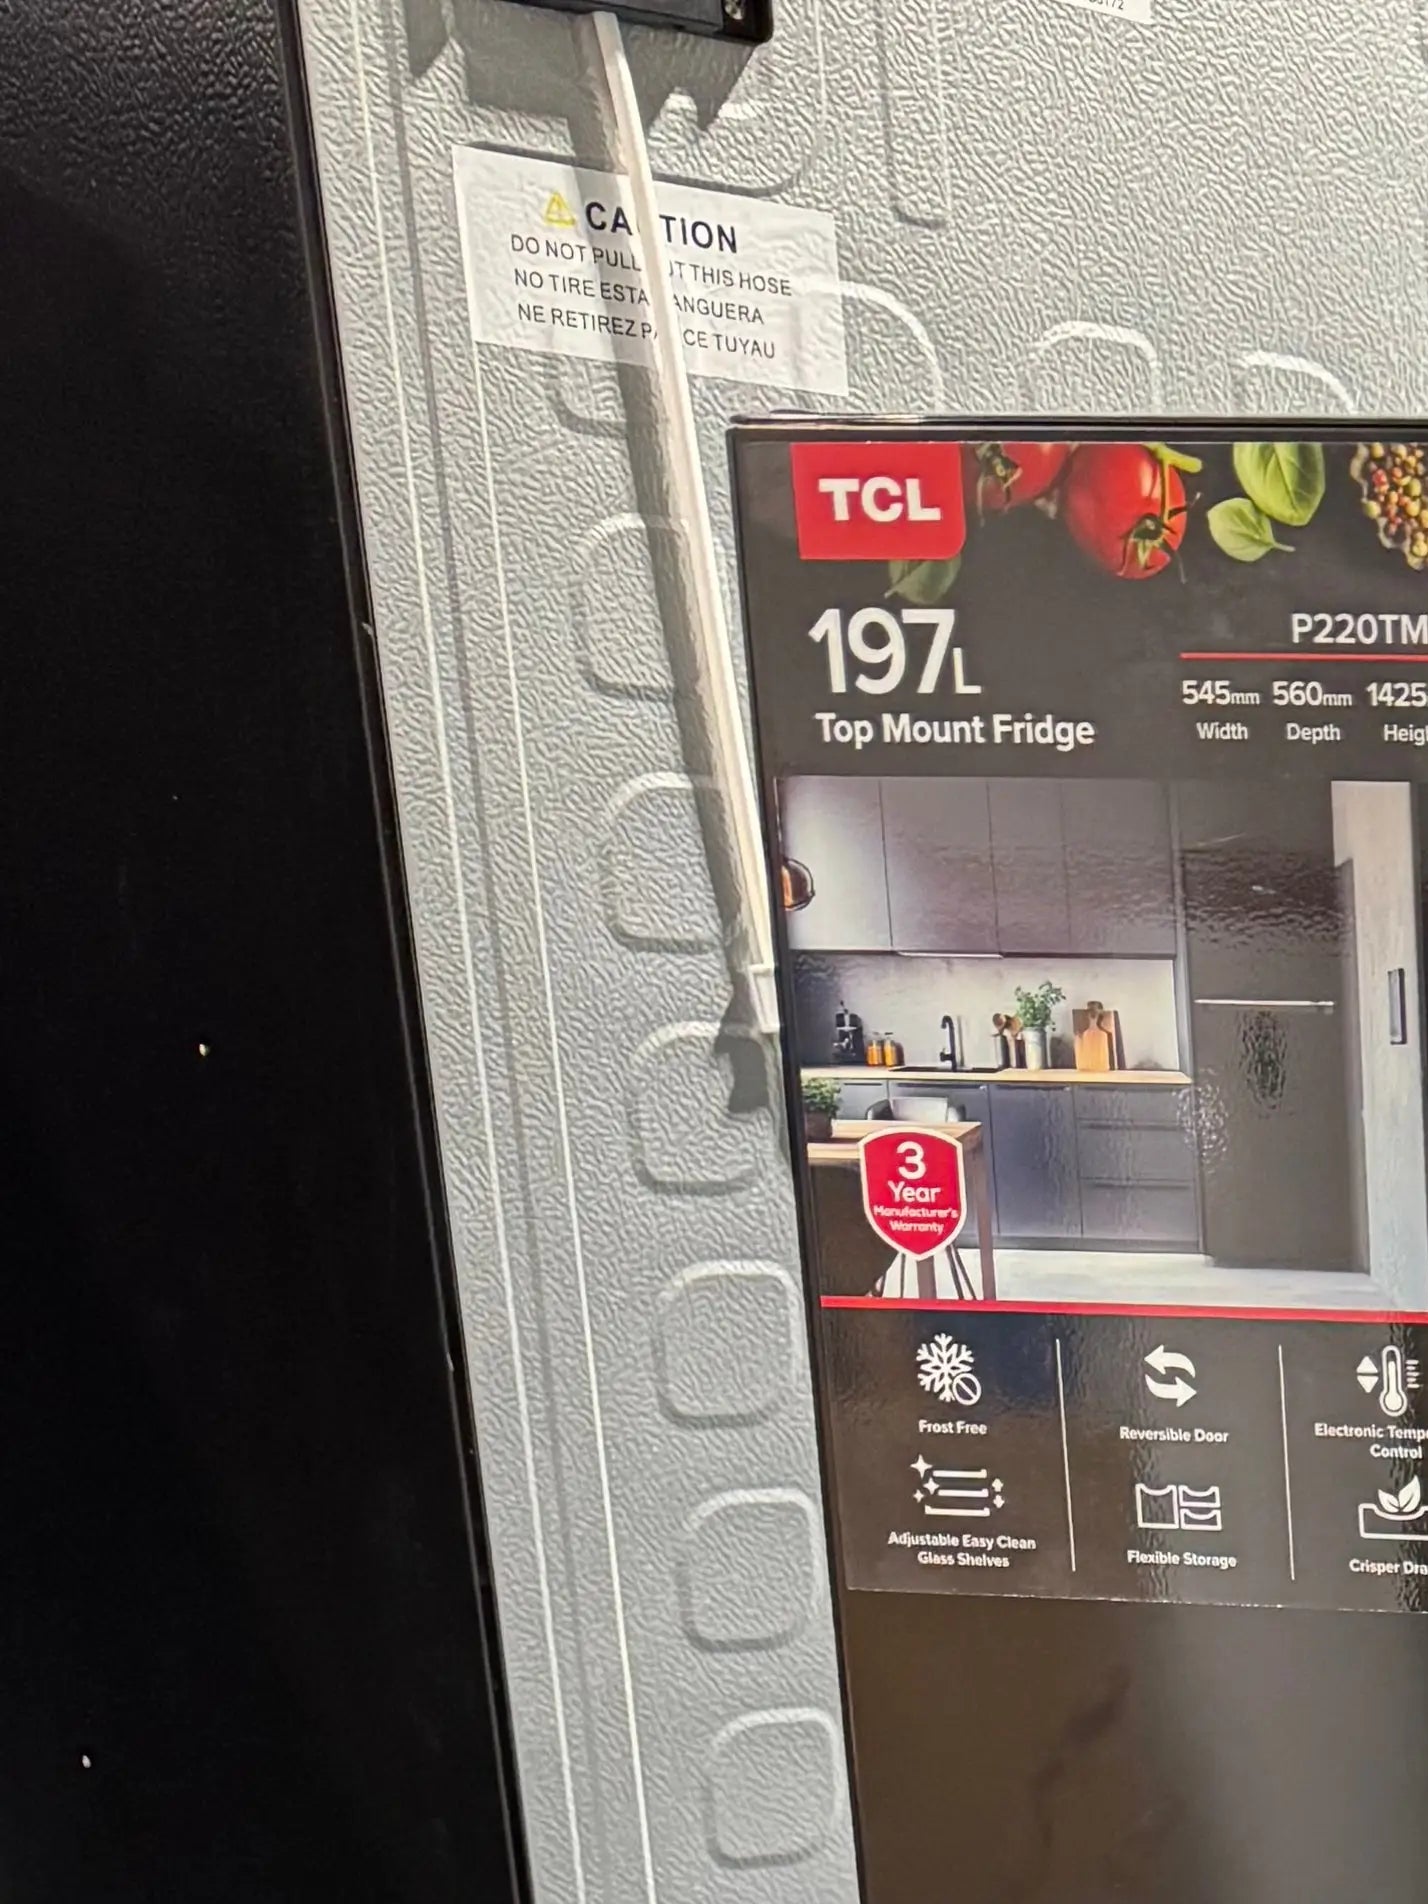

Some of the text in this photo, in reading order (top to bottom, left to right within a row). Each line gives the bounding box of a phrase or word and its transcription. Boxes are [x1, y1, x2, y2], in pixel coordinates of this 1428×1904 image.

[585, 201, 737, 253] CATION
[511, 234, 540, 254] DO
[546, 240, 586, 262] NOT
[592, 247, 642, 271] PULL
[689, 263, 734, 287] THIS
[739, 272, 792, 296] HOSE
[514, 268, 764, 325] NO TIRE ESTA ANGUERA
[518, 304, 545, 323] NE
[551, 308, 637, 337] RETIREZ
[683, 329, 708, 349] CE
[713, 334, 775, 359] TUYAU
[818, 476, 941, 522] TCL
[808, 607, 982, 695] 197L
[1182, 680, 1260, 705] 545mm
[1272, 681, 1352, 706] 560mm
[815, 712, 1095, 752] Top Mount Fridge
[1196, 721, 1248, 740] Width
[1286, 723, 1341, 744] Depth
[896, 1140, 927, 1180] 3
[887, 1180, 942, 1203] Year
[889, 1220, 944, 1236] Warranty
[919, 1420, 988, 1435] Frost Free
[1119, 1426, 1229, 1443] Reversible Door
[1314, 1422, 1384, 1439] Electronic
[1370, 1444, 1423, 1459] Control
[888, 1531, 1037, 1550] Adjustable Easy Clean
[917, 1551, 1010, 1567] Glass Shelves
[1127, 1550, 1237, 1569] Flexible Storage
[1349, 1558, 1400, 1575] Crisper
